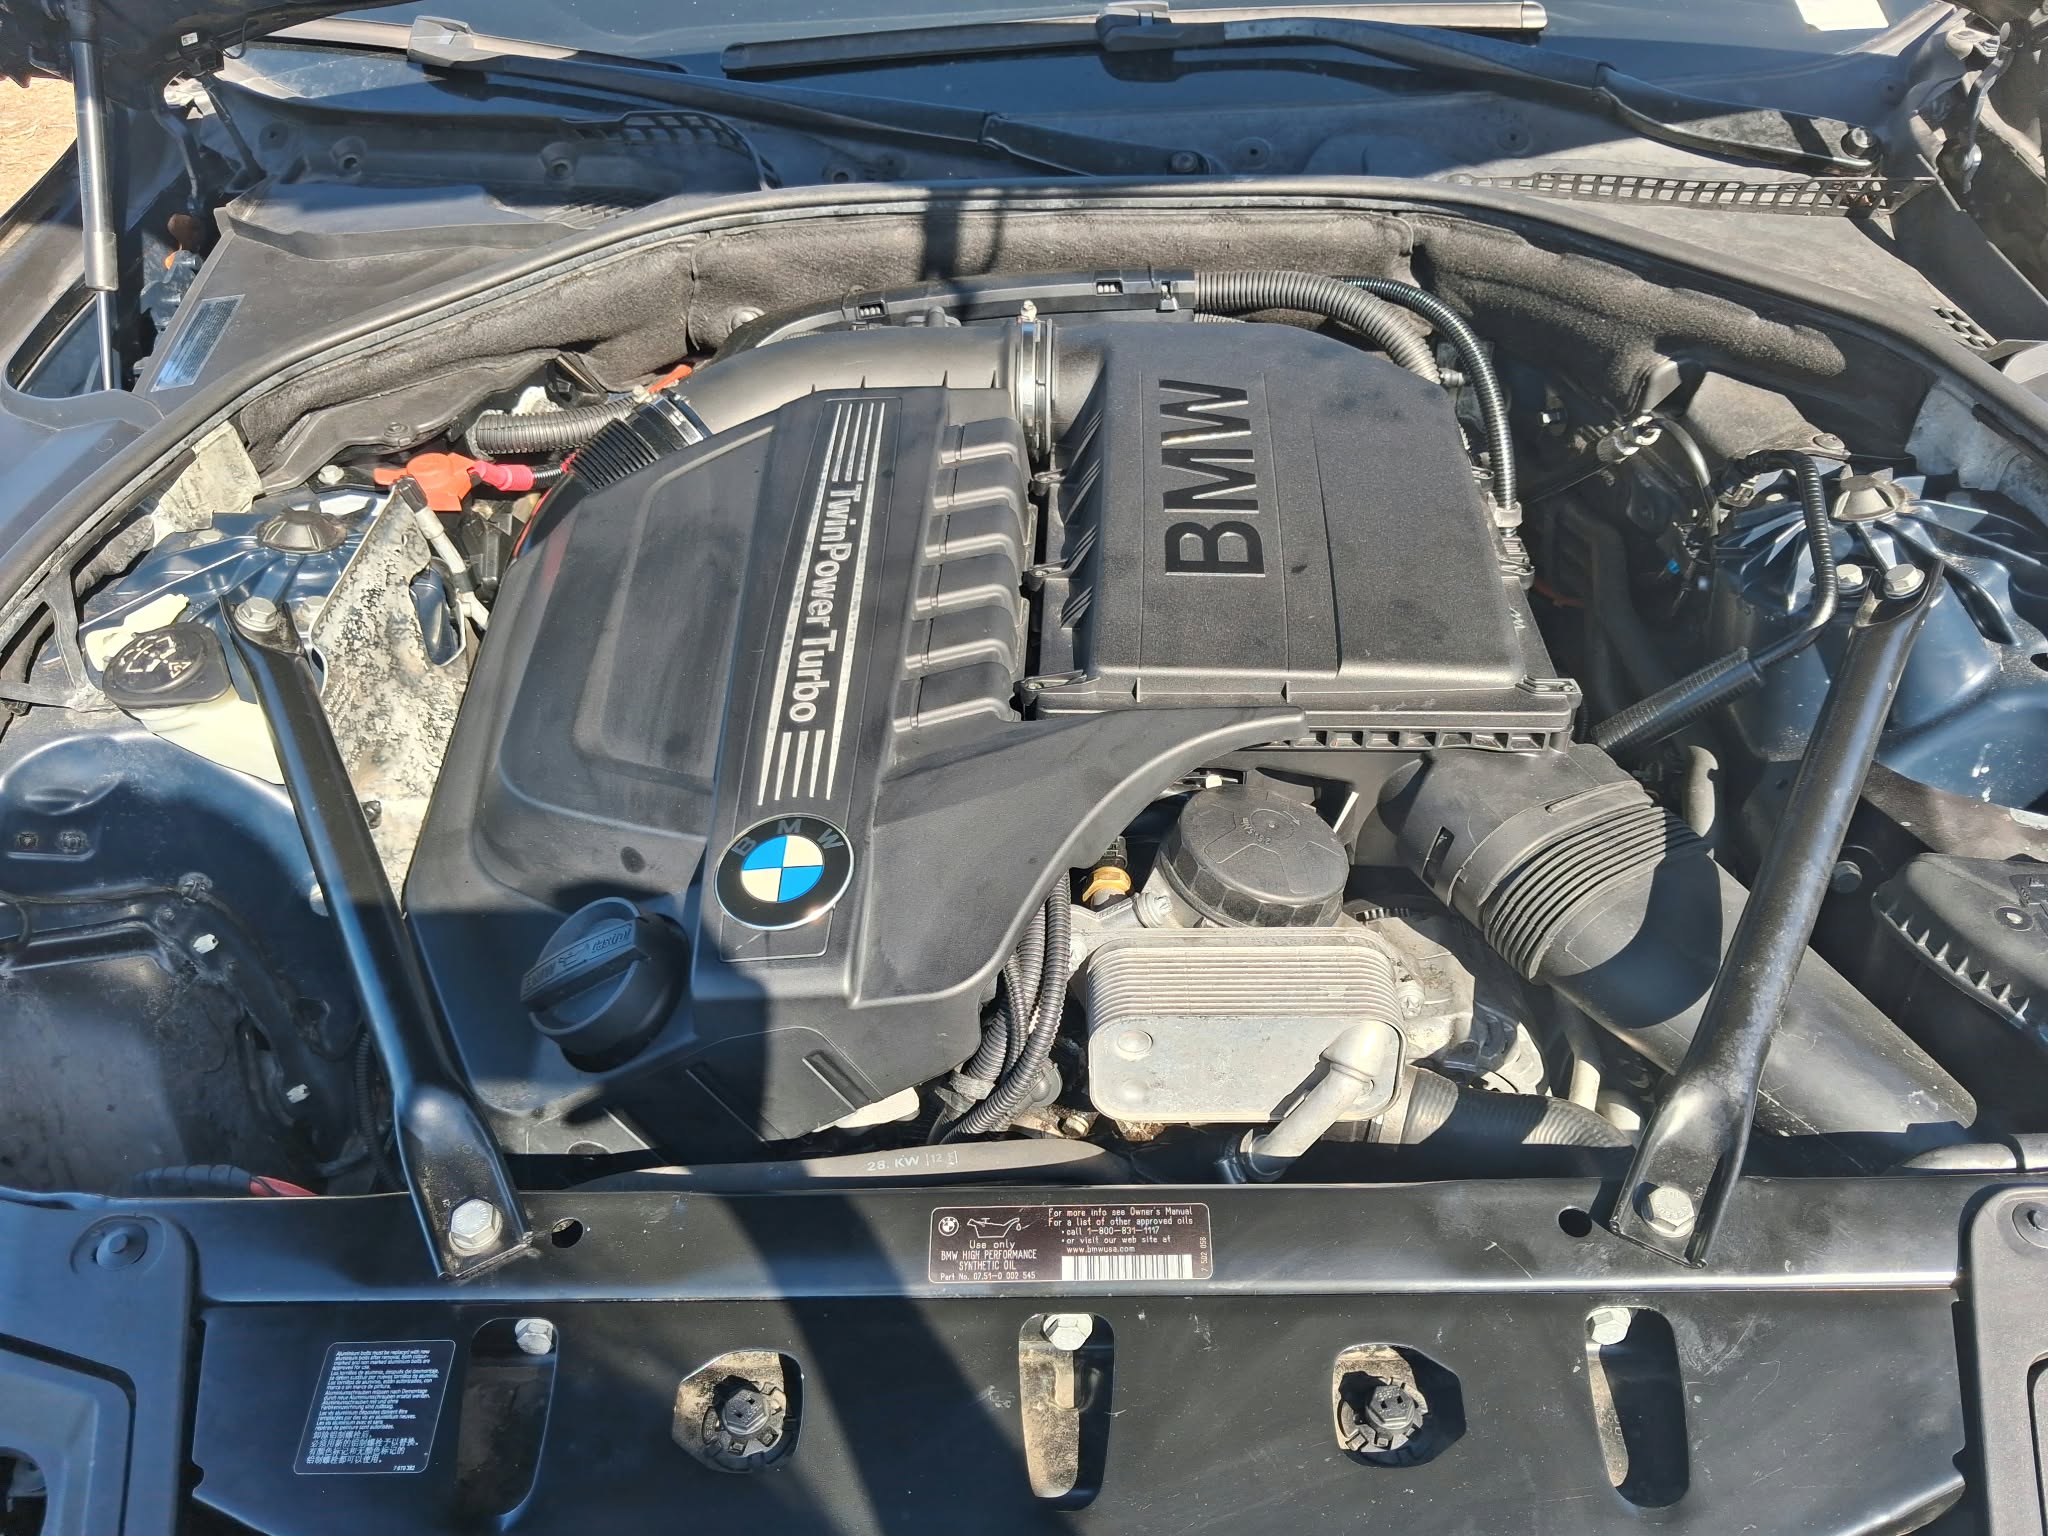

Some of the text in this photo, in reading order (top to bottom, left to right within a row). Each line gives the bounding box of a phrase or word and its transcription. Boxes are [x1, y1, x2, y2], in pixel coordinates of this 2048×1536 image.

[1159, 378, 1265, 578] BMW
[789, 483, 862, 722] TwinPower Turbo
[730, 819, 844, 857] BMW
[895, 1155, 920, 1168] KW
[1048, 1208, 1062, 1217] For
[1091, 1208, 1107, 1216] info
[1130, 1207, 1161, 1215] Owner's
[1165, 1206, 1193, 1215] Manual
[1048, 1217, 1062, 1226] For
[1077, 1217, 1091, 1226] list
[1096, 1217, 1105, 1226] of
[1110, 1217, 1131, 1226] other
[1136, 1216, 1173, 1227] approved
[1177, 1216, 1193, 1225] oils
[969, 1238, 1016, 1250] Use only
[1080, 1236, 1099, 1244] visit
[1162, 1235, 1171, 1243] at
[941, 1248, 1038, 1261] BMW HIGH PERFORMANCE
[1066, 1245, 1136, 1254] www.bmwusa.com
[959, 1260, 1017, 1271] SYNTHETIC OIL
